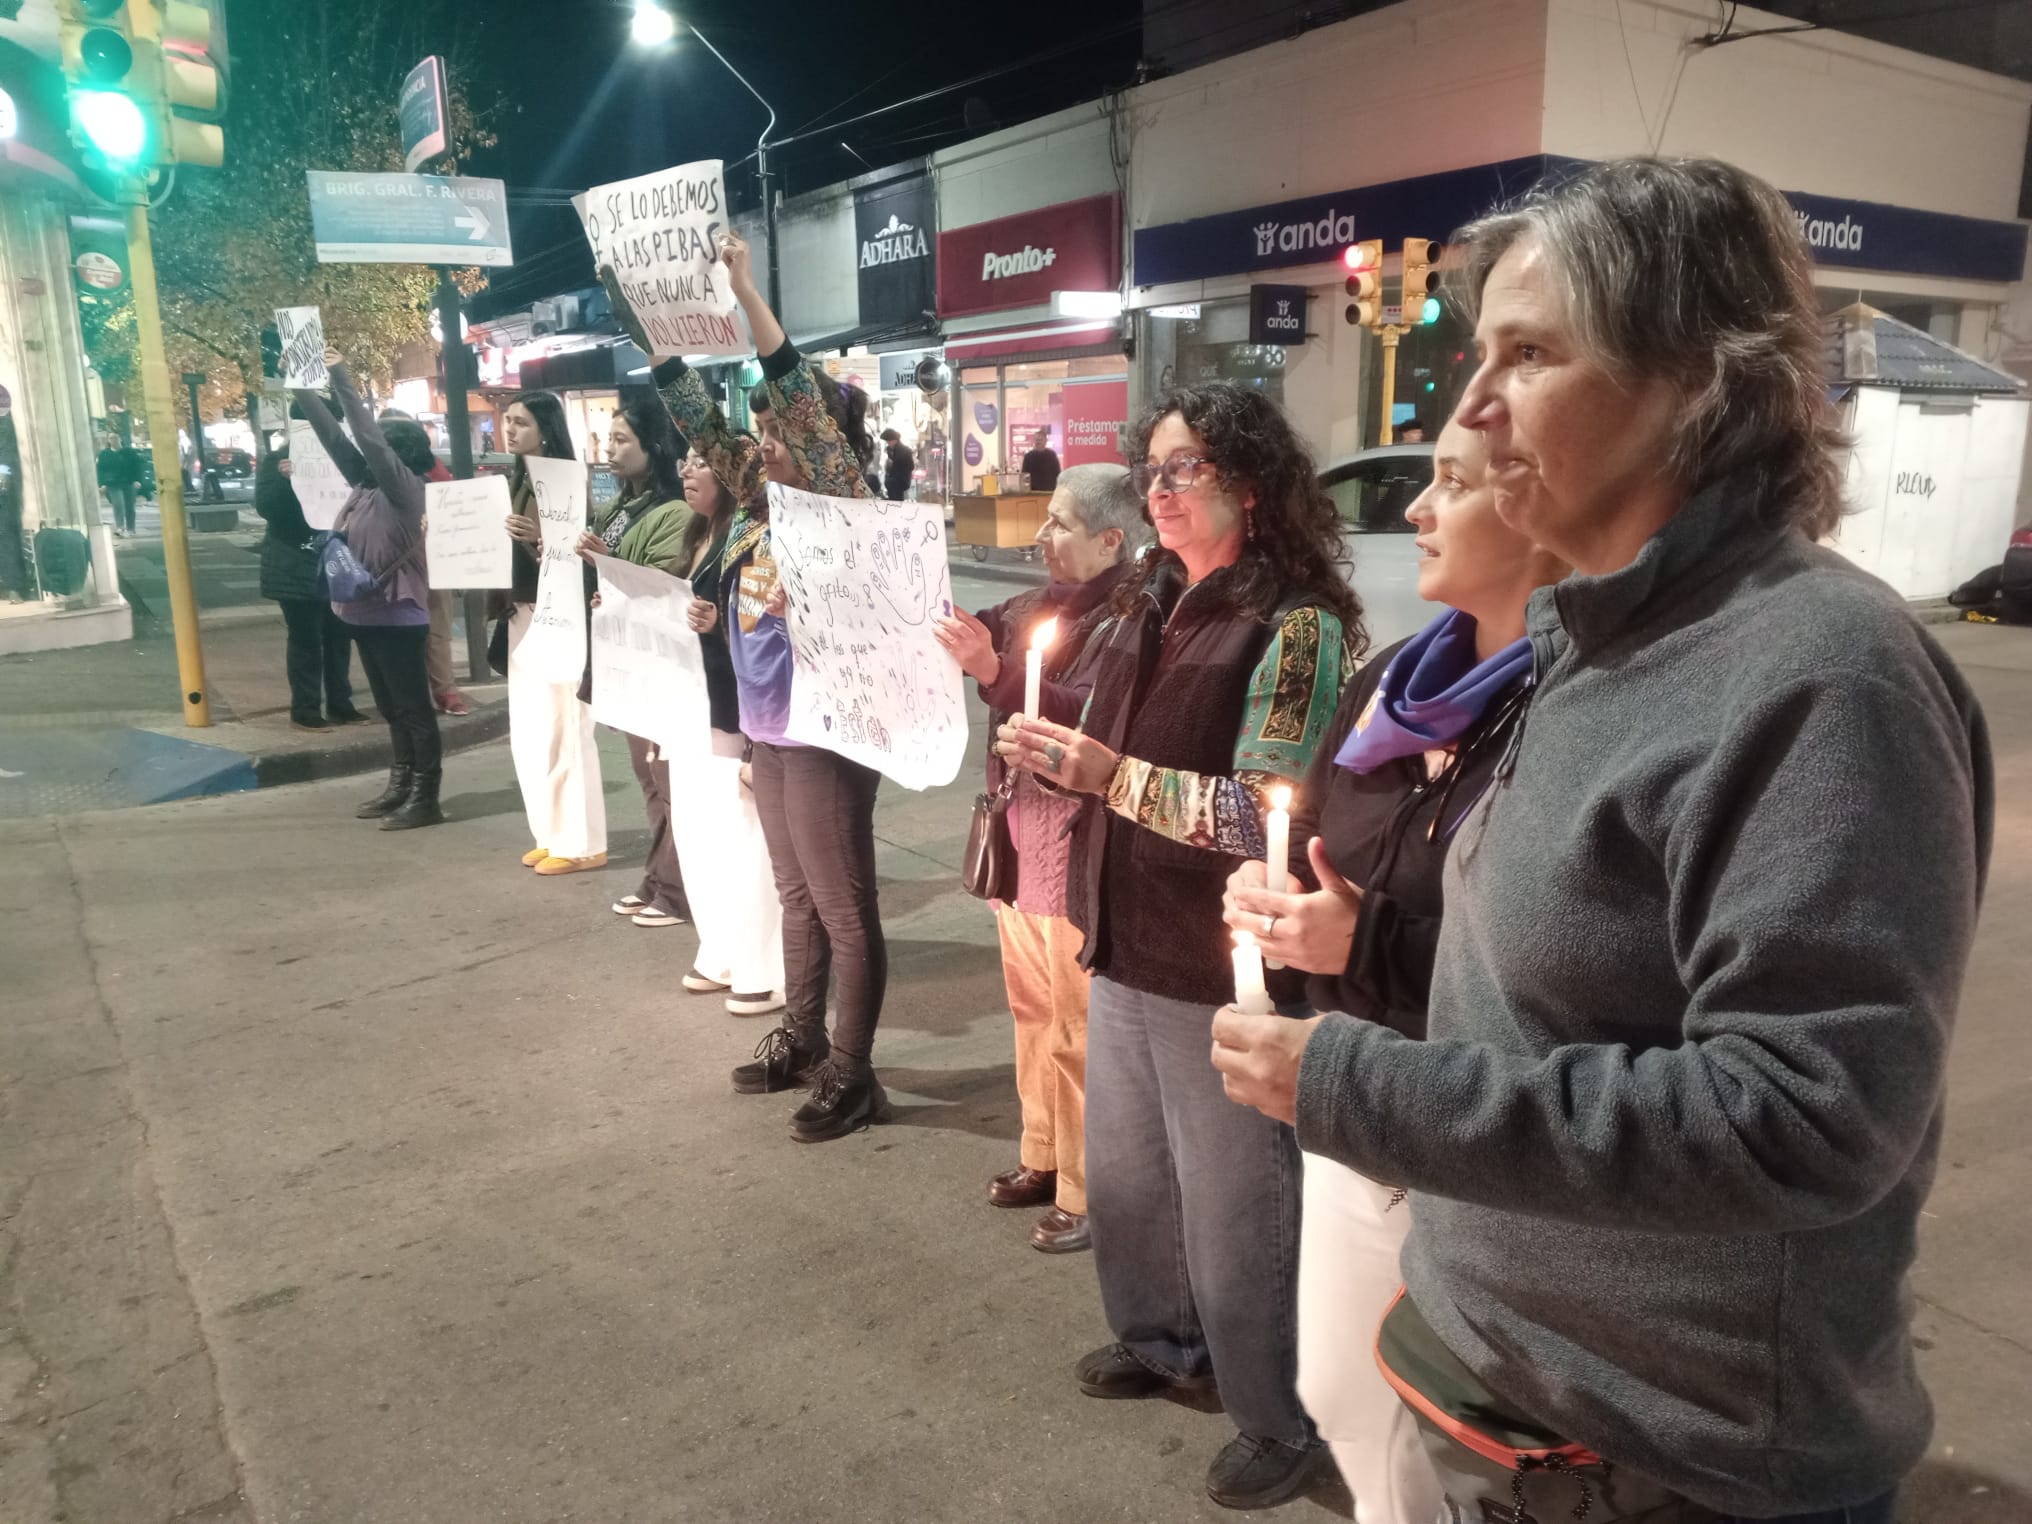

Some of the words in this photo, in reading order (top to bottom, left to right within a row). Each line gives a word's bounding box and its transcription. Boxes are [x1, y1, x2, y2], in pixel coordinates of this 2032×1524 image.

[325, 181, 371, 196] BRIG.
[374, 183, 422, 198] GRAL.
[441, 186, 497, 202] RIVERA
[607, 193, 625, 234] SE
[631, 191, 648, 220] LO
[653, 177, 719, 219] DEBEMOS
[612, 246, 624, 272] A
[624, 236, 651, 269] LAS
[653, 222, 721, 264] PIBAS
[1280, 209, 1355, 251] anda
[1808, 214, 1864, 251] anda
[859, 227, 931, 269] ADHARA
[622, 282, 656, 309] QUE
[656, 273, 718, 303] NUNCA
[642, 313, 738, 347] VOLVIERON
[1267, 315, 1299, 329] anda
[1067, 417, 1119, 433] Préstamo
[1075, 434, 1107, 446] medida
[844, 540, 856, 570] el
[850, 643, 869, 669] que
